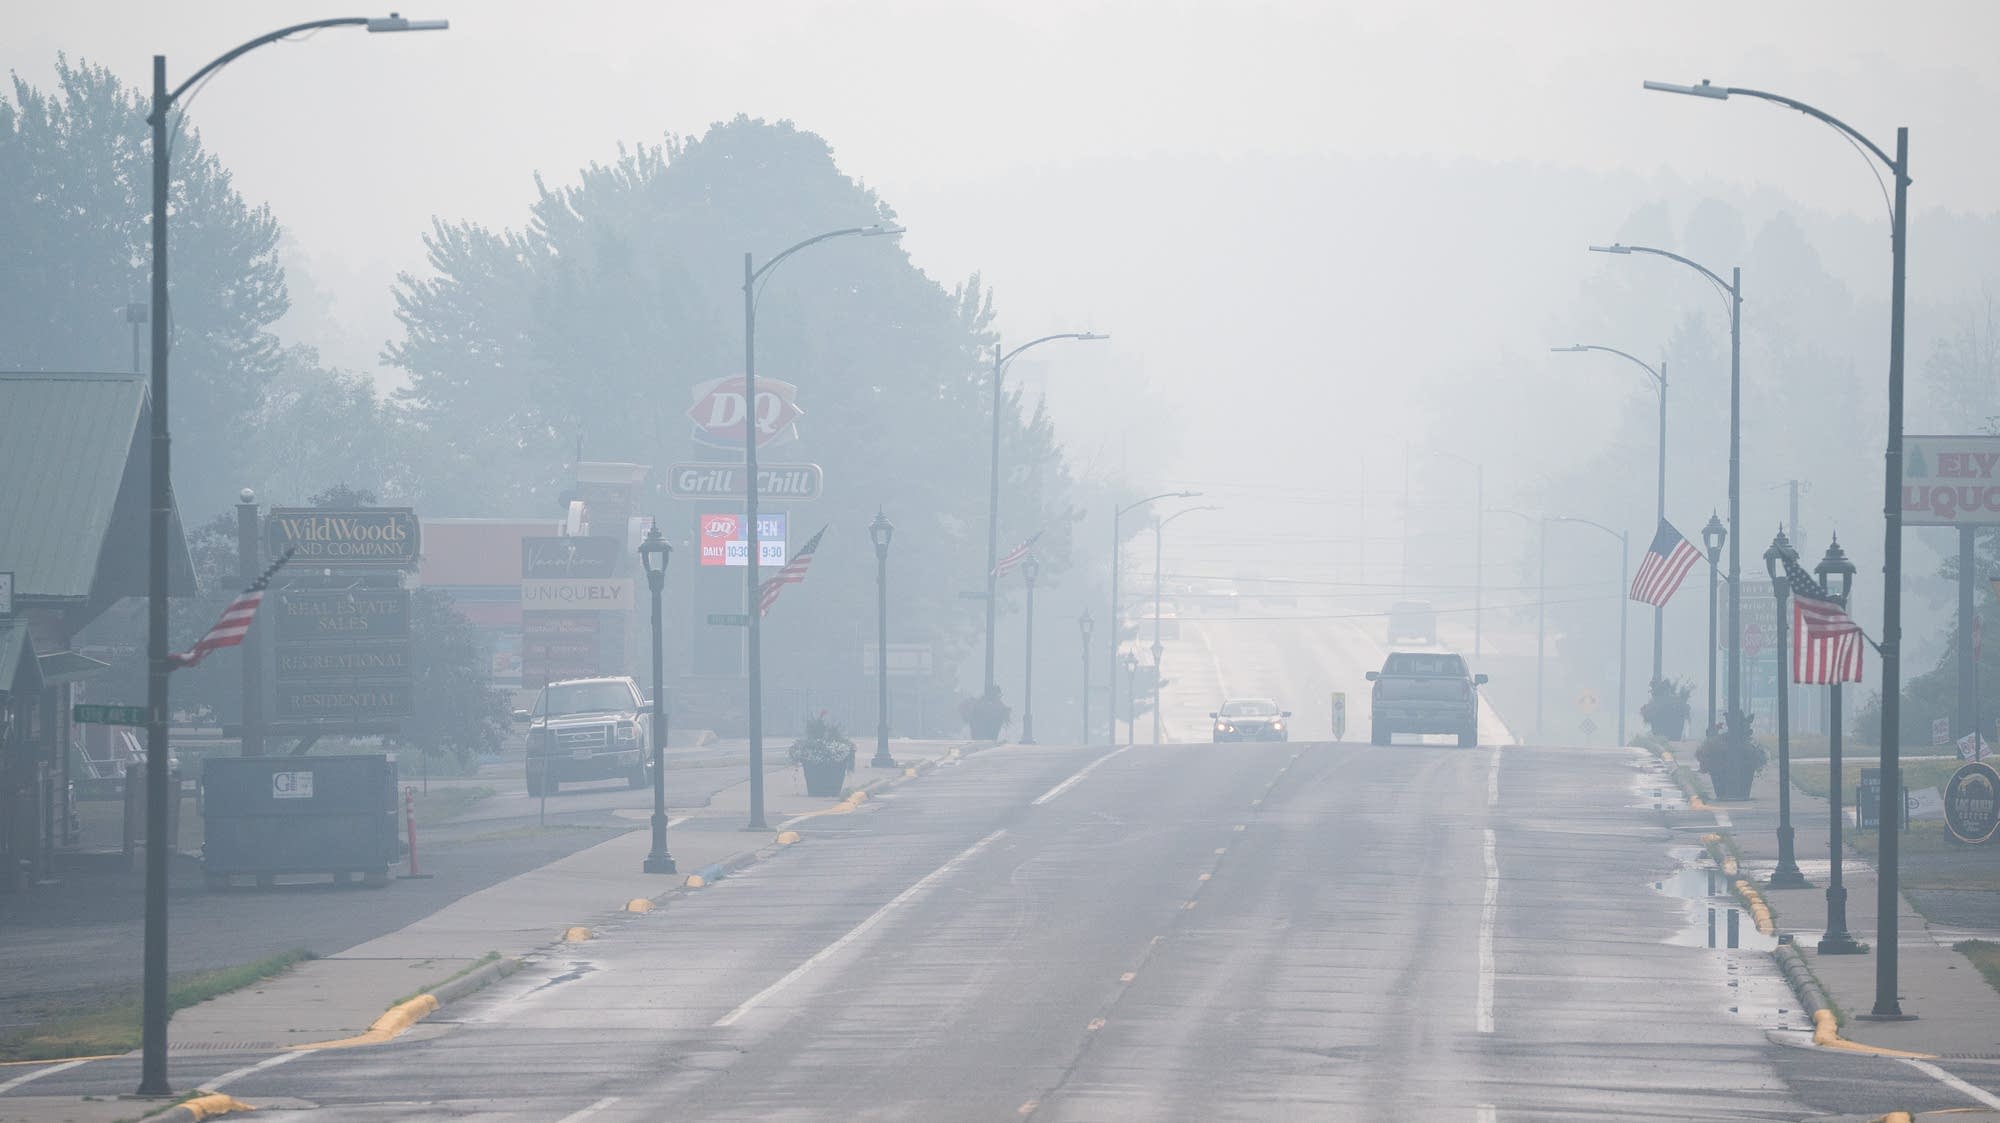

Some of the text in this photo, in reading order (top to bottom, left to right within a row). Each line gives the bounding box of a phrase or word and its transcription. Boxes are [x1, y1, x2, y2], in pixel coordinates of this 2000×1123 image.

[705, 392, 782, 433] DQ
[1936, 453, 1999, 478] ELY
[679, 470, 811, 493] Grill Chill
[281, 517, 407, 541] WildWoods
[711, 521, 732, 534] DQ
[328, 543, 405, 555] COMPANY
[703, 546, 724, 556] DAILY
[762, 546, 782, 558] 9:30
[526, 584, 621, 602] UNIQUELY
[287, 599, 400, 615] REAL ESTATE
[319, 616, 369, 630] SALES
[281, 655, 406, 669] RECREATIONAL
[290, 694, 397, 707] RESIDENTIAL
